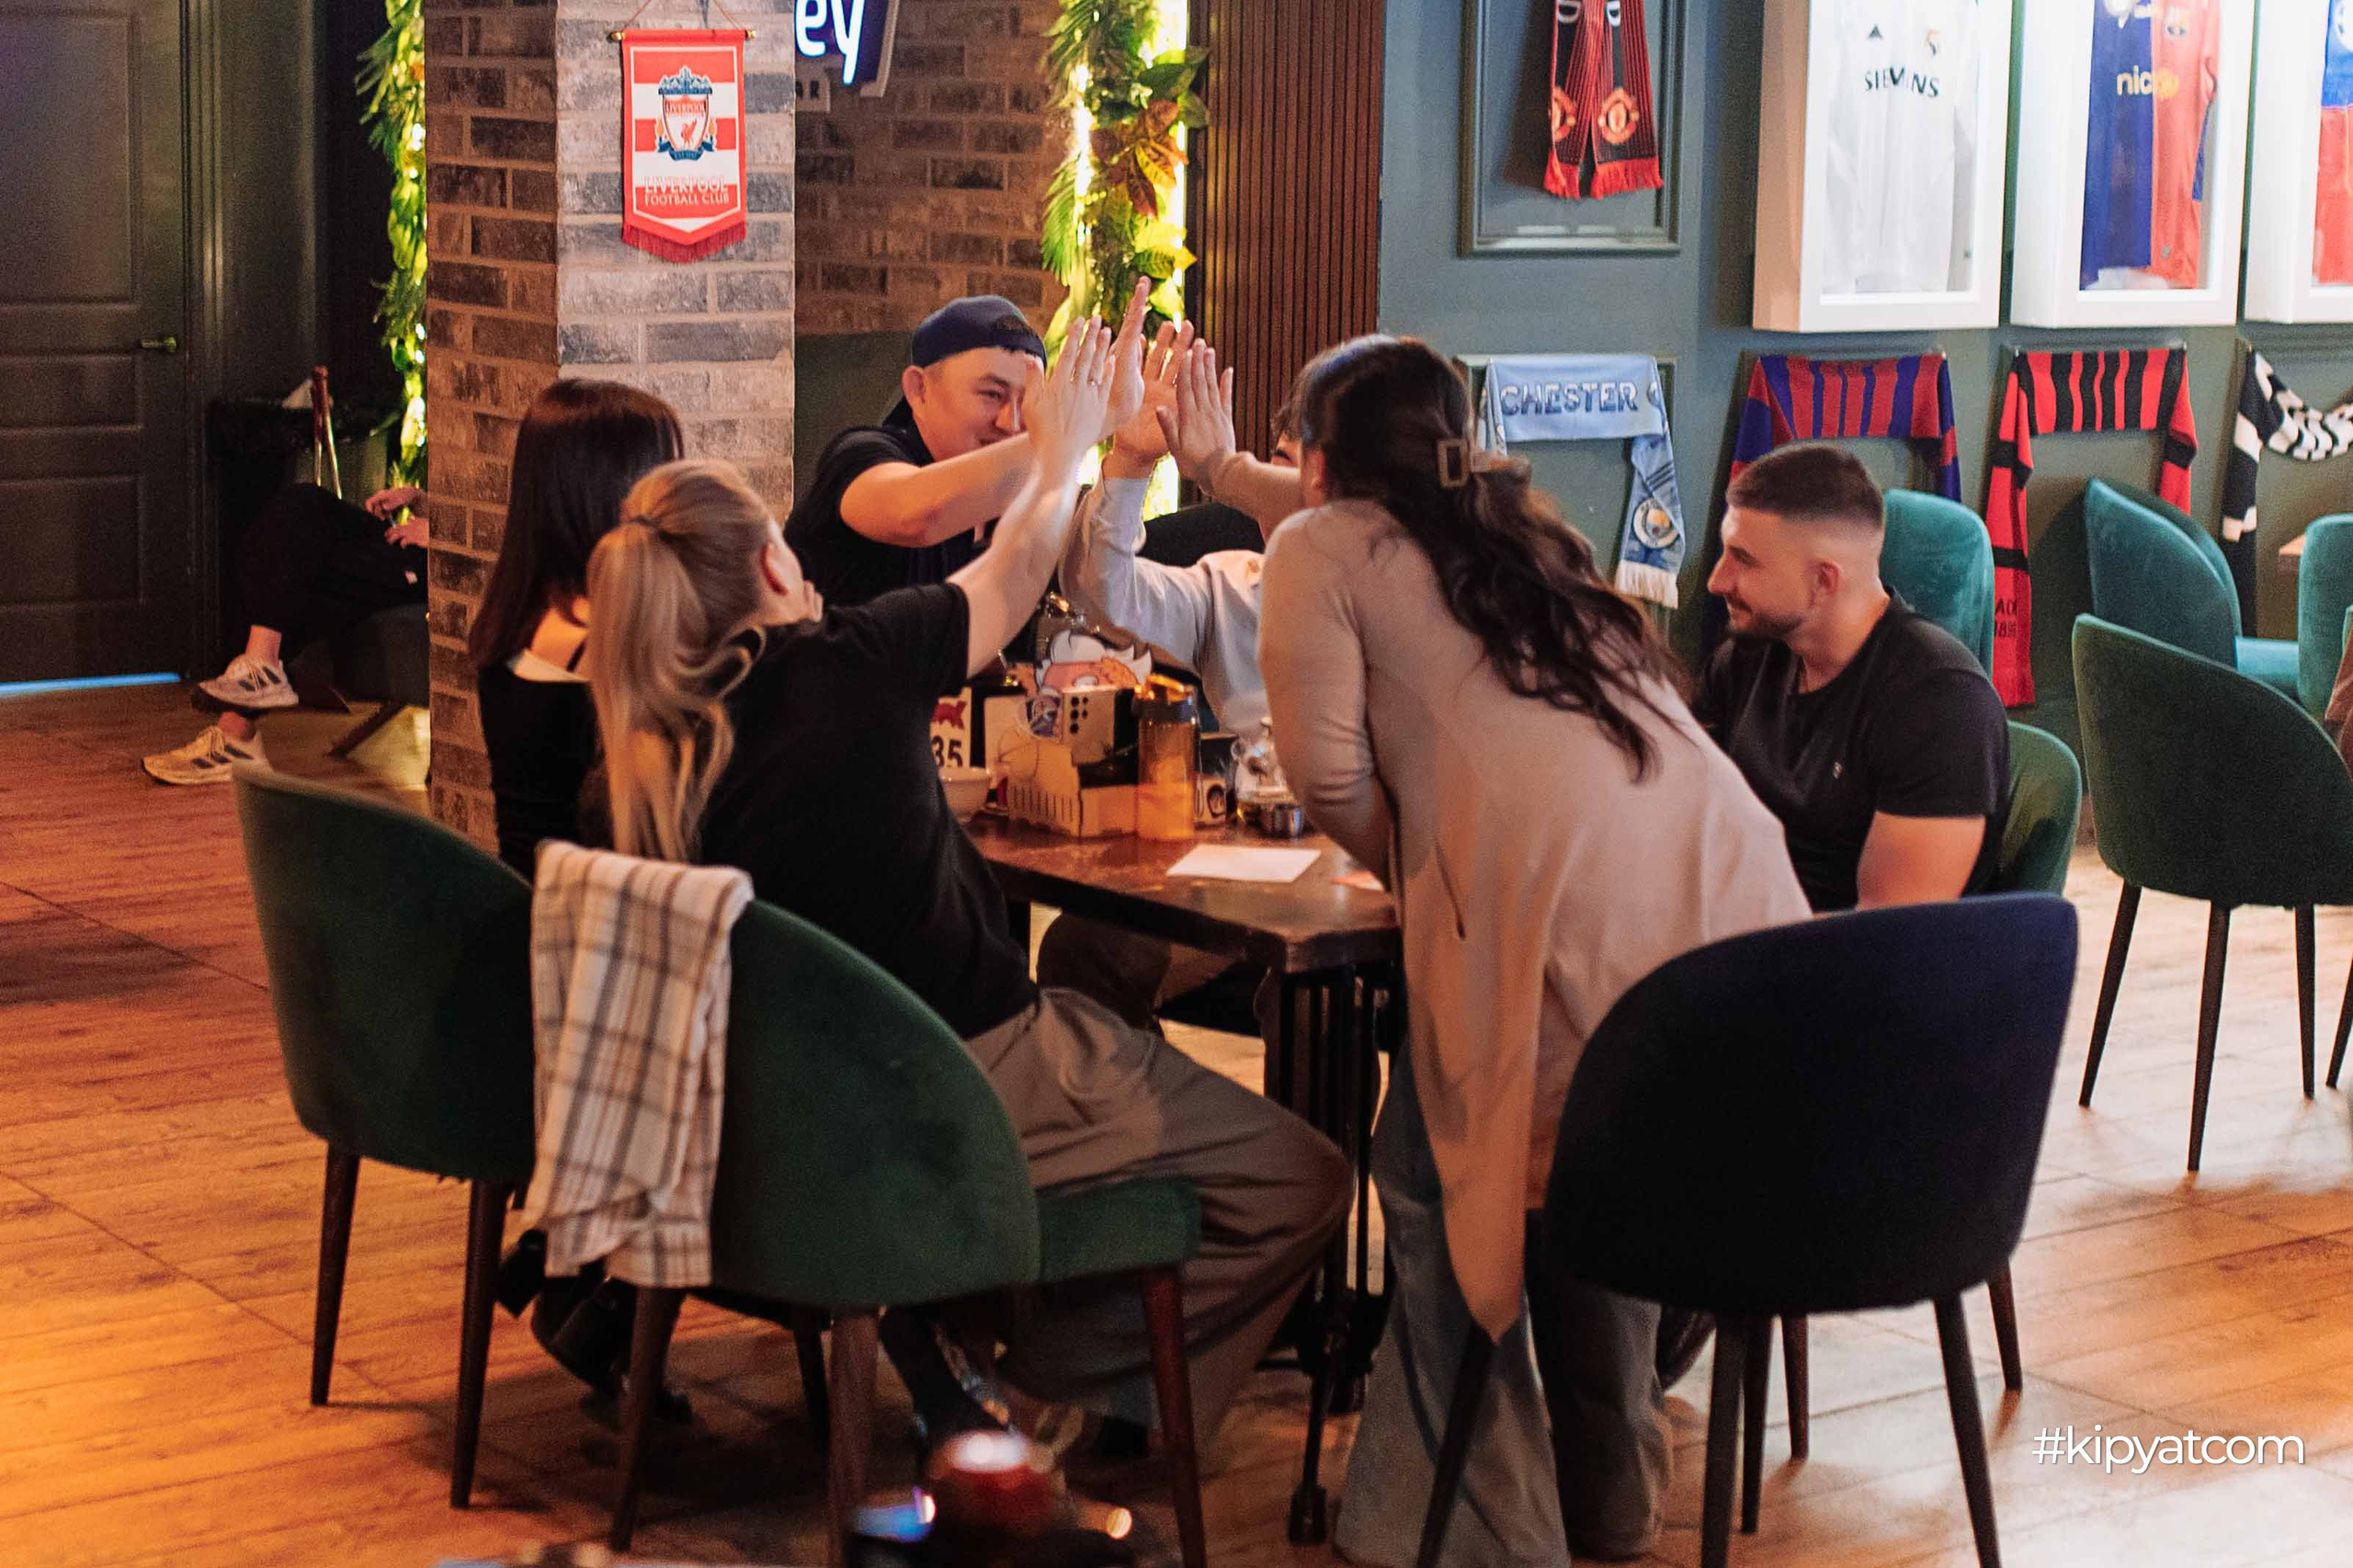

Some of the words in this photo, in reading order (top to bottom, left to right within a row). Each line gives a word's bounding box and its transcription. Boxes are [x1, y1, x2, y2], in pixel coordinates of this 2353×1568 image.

[644, 176, 728, 194] LIVERPOOL
[644, 194, 698, 206] FOOTBALL
[701, 193, 730, 205] CLUB
[1500, 381, 1638, 415] CHESTER
